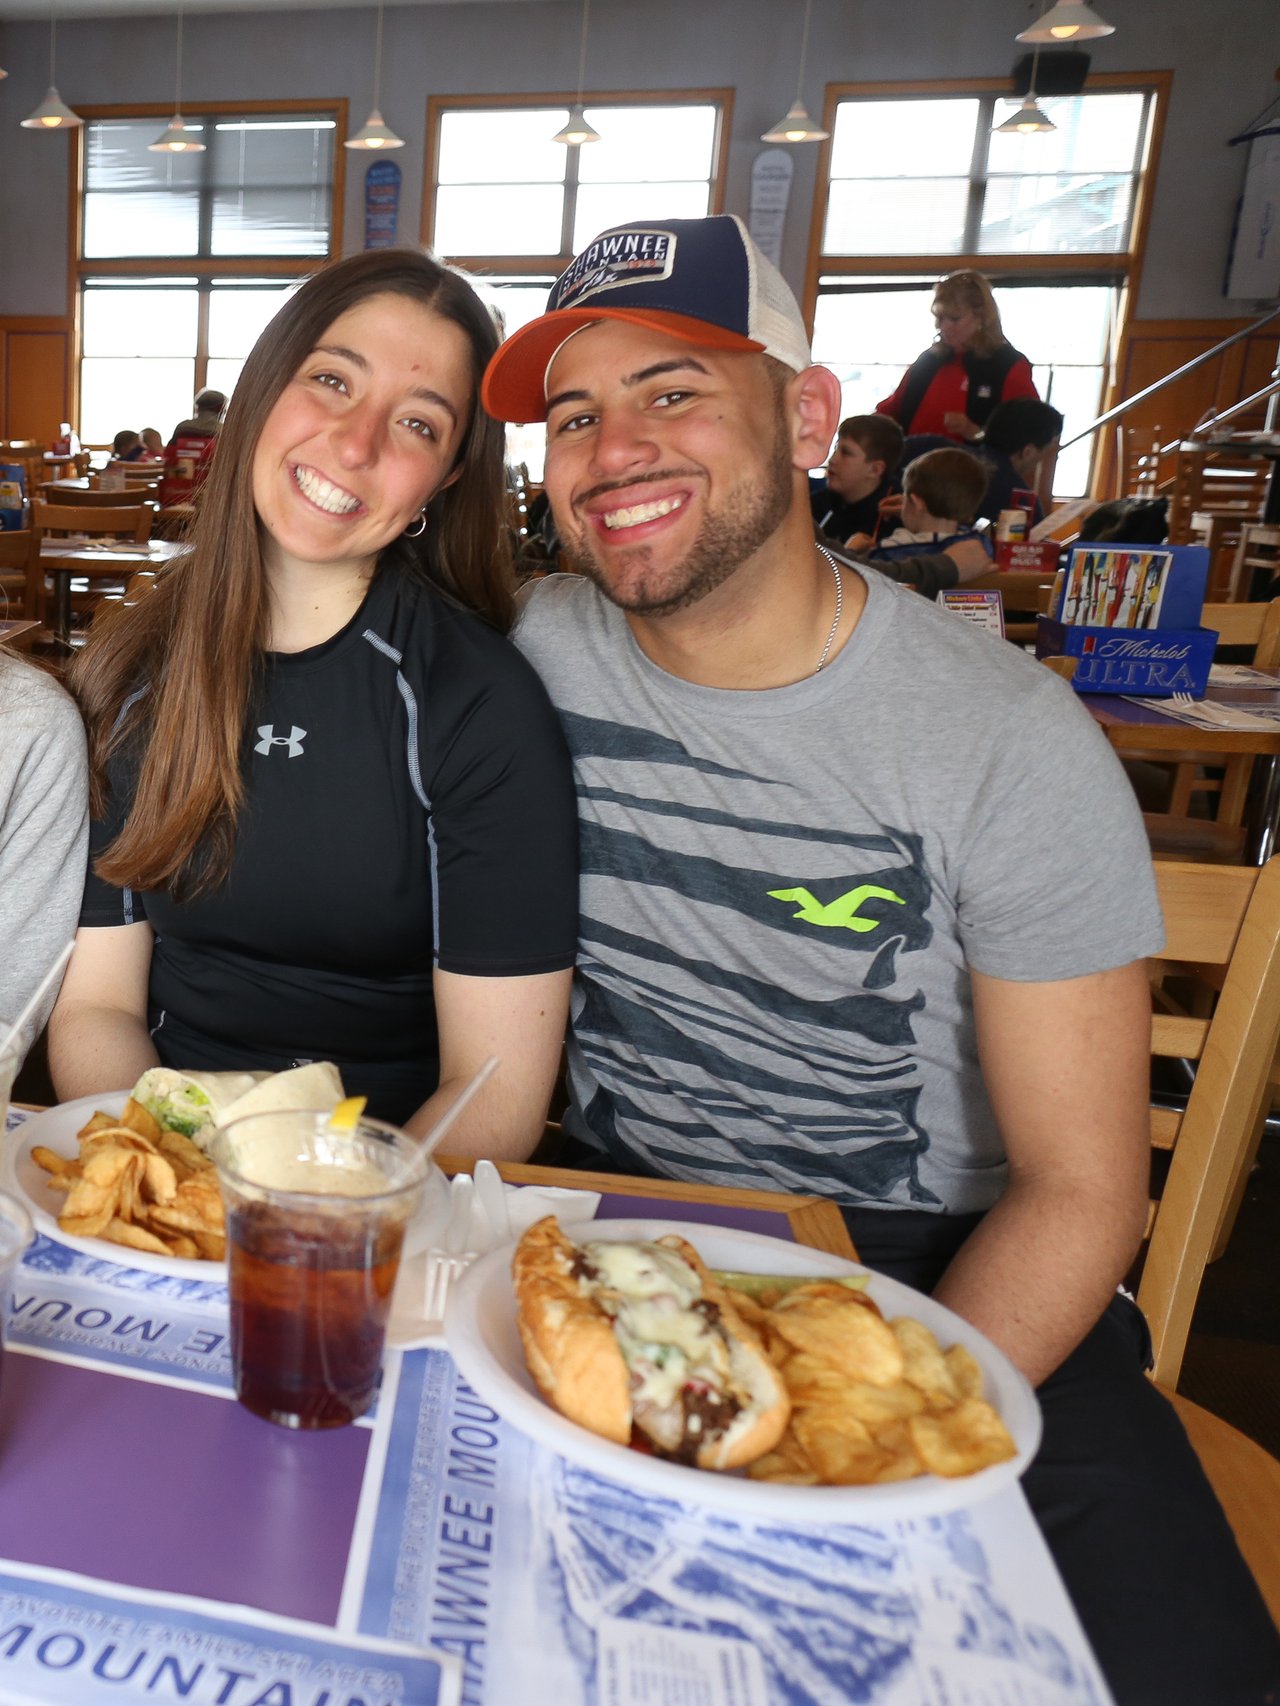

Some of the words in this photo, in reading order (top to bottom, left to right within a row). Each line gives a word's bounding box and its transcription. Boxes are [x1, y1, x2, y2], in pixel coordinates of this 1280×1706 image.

[562, 235, 669, 292] SHAWNEE
[1098, 638, 1193, 660] Michelob
[1073, 658, 1196, 689] ULTRA
